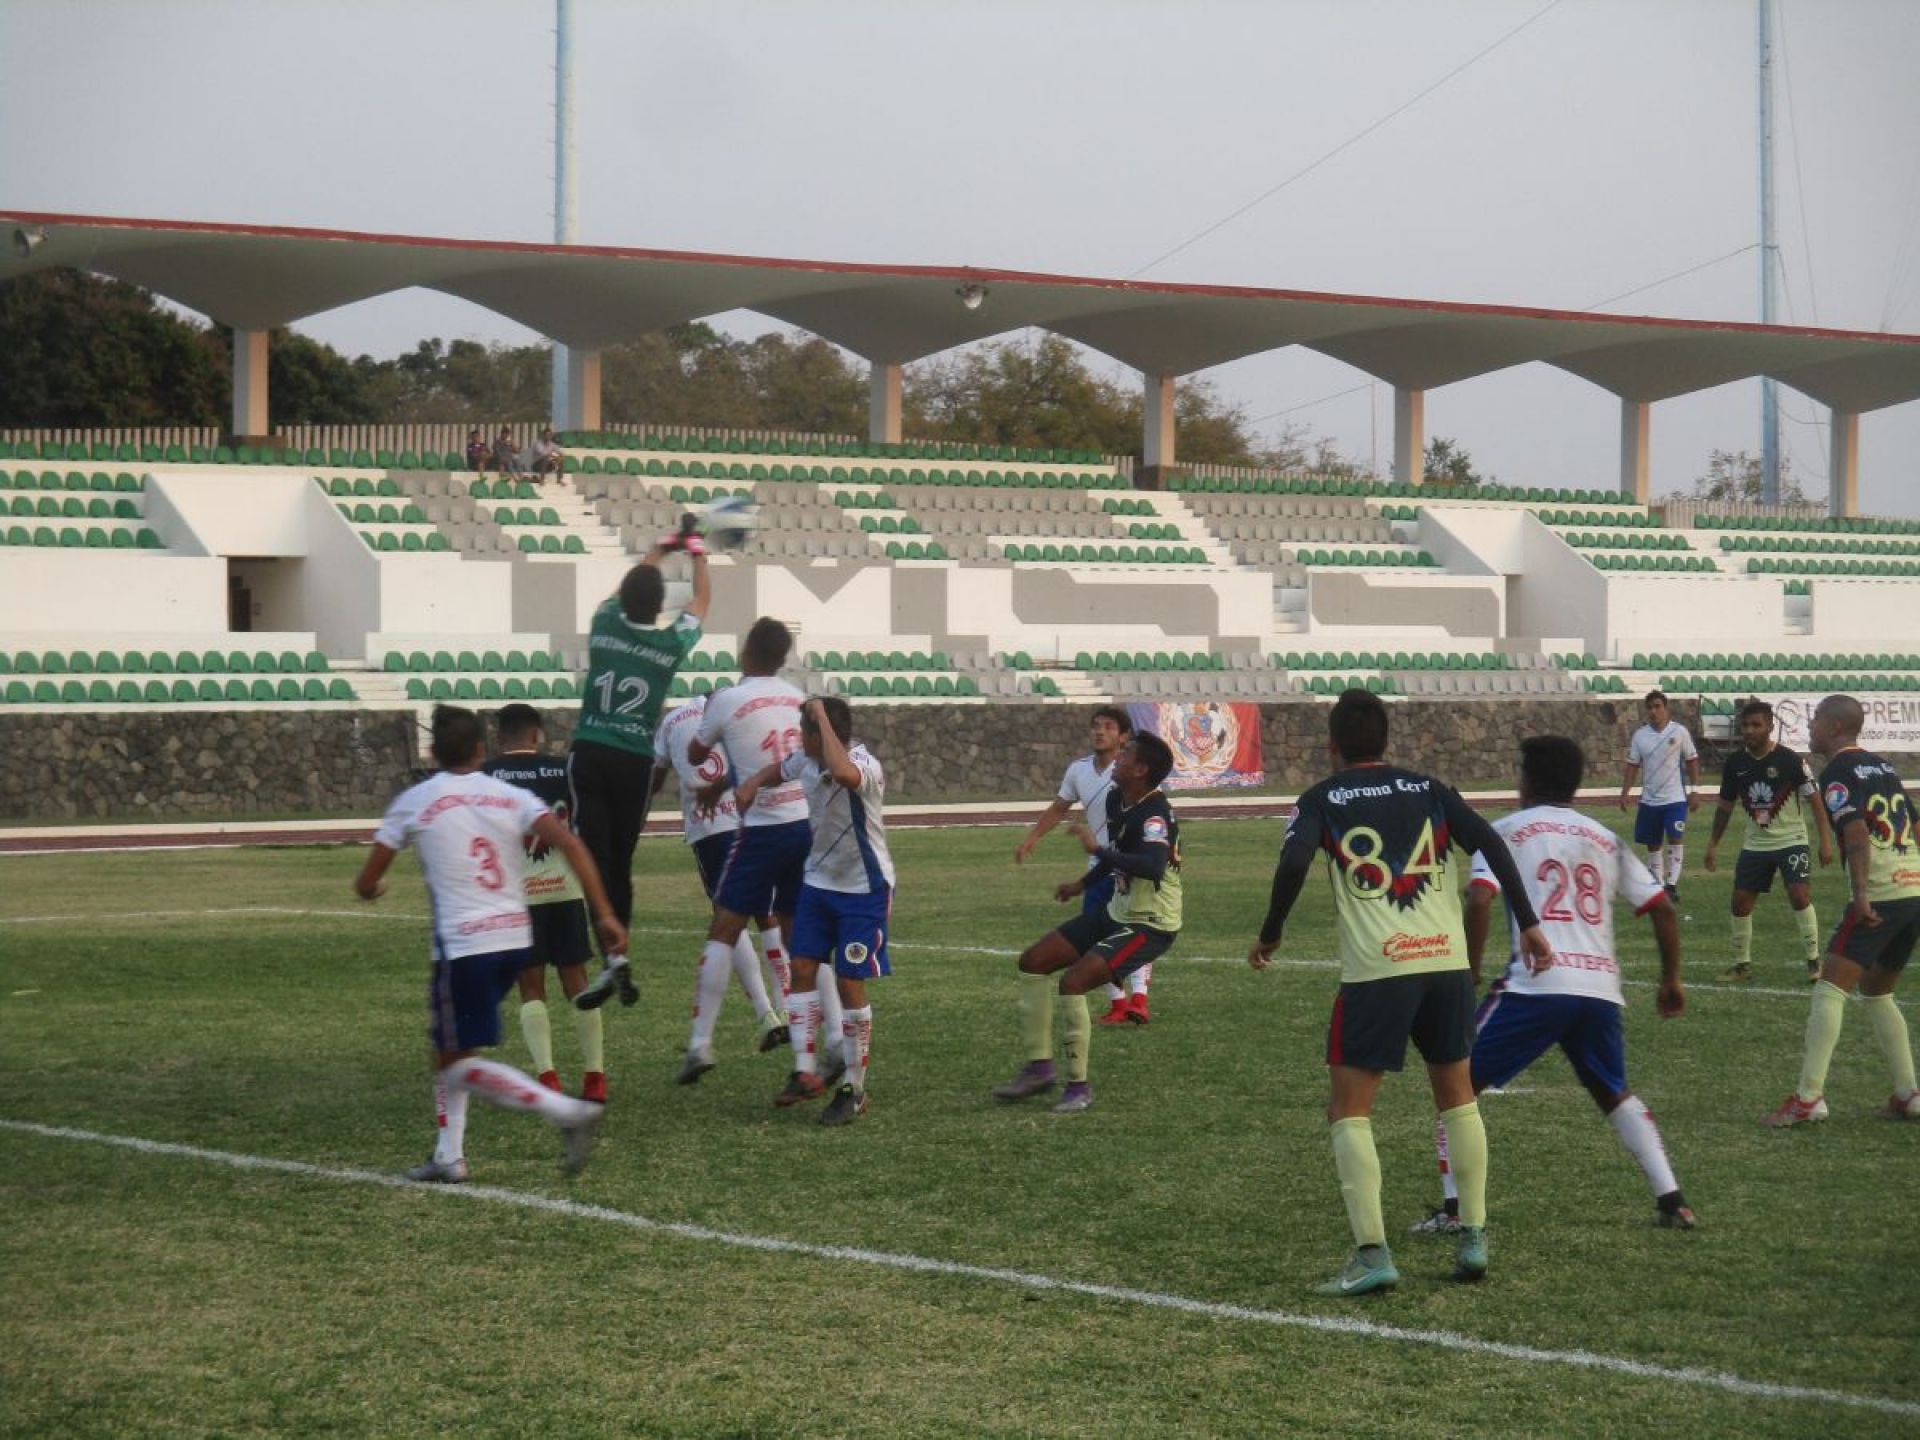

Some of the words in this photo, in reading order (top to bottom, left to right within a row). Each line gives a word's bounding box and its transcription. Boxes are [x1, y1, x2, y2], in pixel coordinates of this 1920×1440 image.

[594, 670, 649, 715] 12
[1328, 783, 1393, 806] Corona
[1867, 793, 1917, 850] 32
[469, 836, 507, 891] 3
[1341, 816, 1446, 900] 84
[1788, 851, 1810, 872] 99
[1536, 858, 1604, 926] 28
